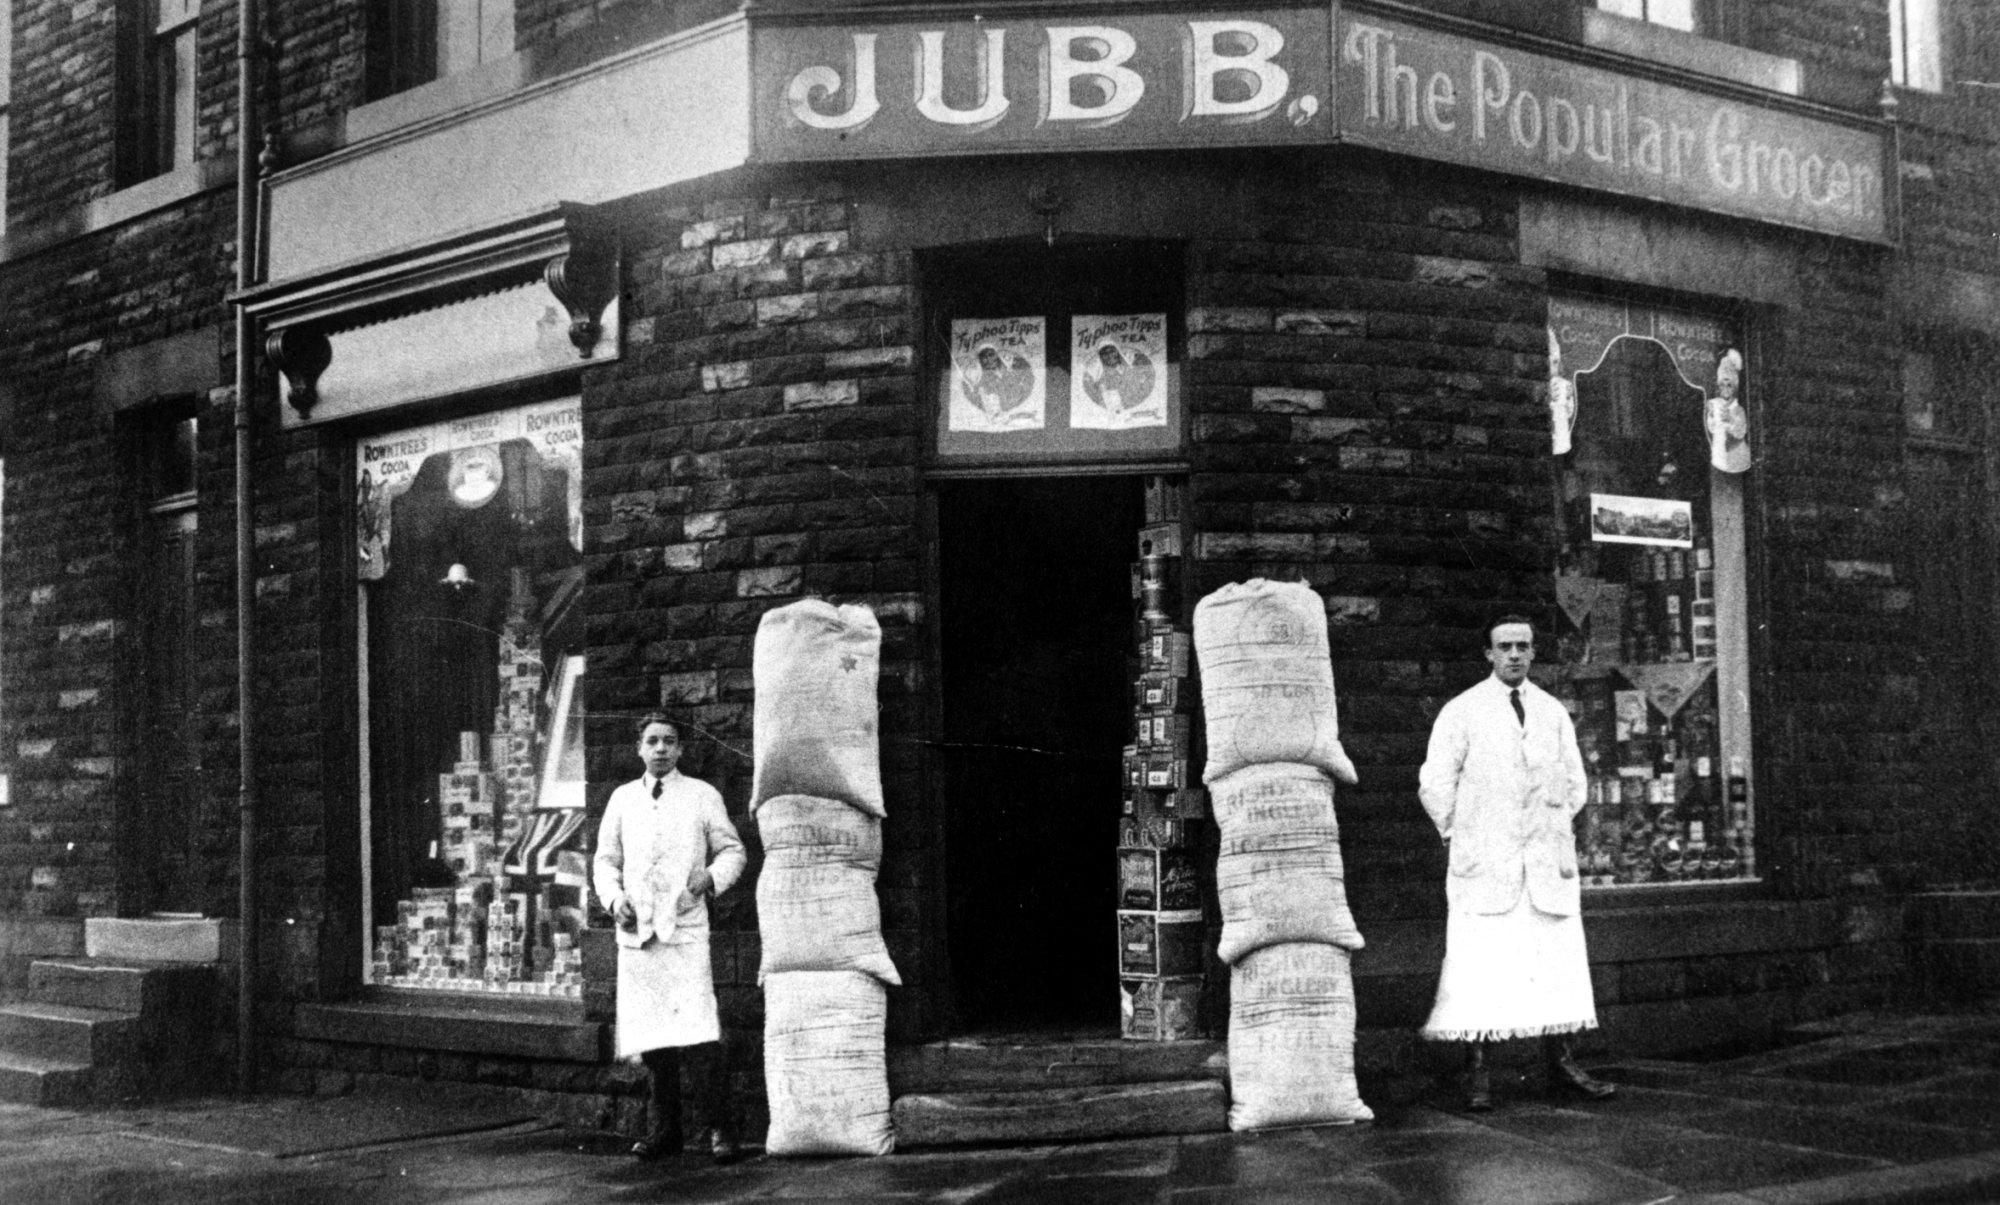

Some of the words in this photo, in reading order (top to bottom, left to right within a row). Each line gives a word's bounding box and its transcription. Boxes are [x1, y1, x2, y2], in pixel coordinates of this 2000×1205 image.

[1343, 22, 1458, 131] The
[1471, 50, 1696, 179] Popular
[1000, 336, 1027, 346] TEA
[1120, 333, 1147, 343] TEA
[545, 428, 579, 445] COCOA
[380, 460, 409, 476] COCOA
